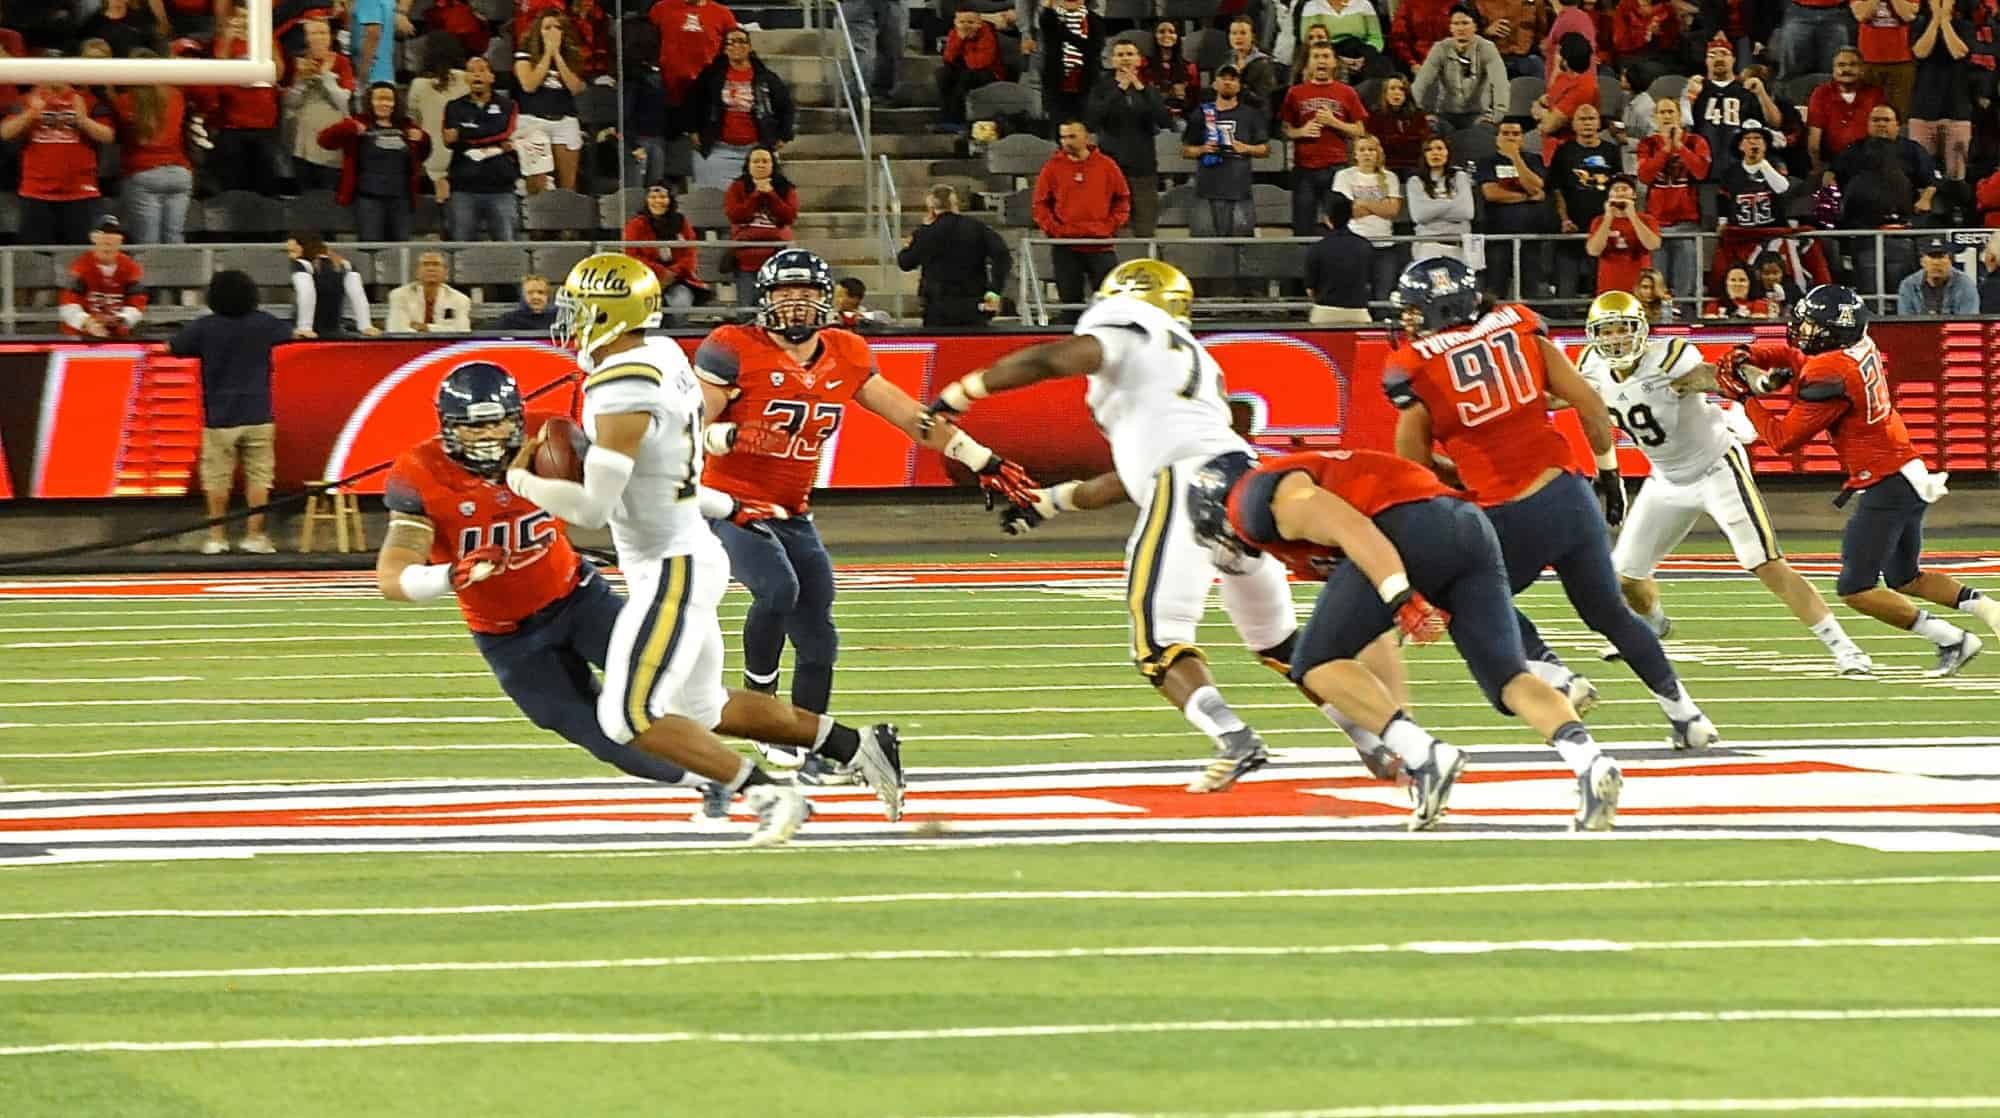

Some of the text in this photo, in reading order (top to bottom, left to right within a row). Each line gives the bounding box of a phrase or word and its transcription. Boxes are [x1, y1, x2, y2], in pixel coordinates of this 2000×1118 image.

[1704, 97, 1740, 126] 48
[578, 268, 631, 298] Ucla
[1445, 329, 1537, 427] 91
[763, 400, 845, 461] 33
